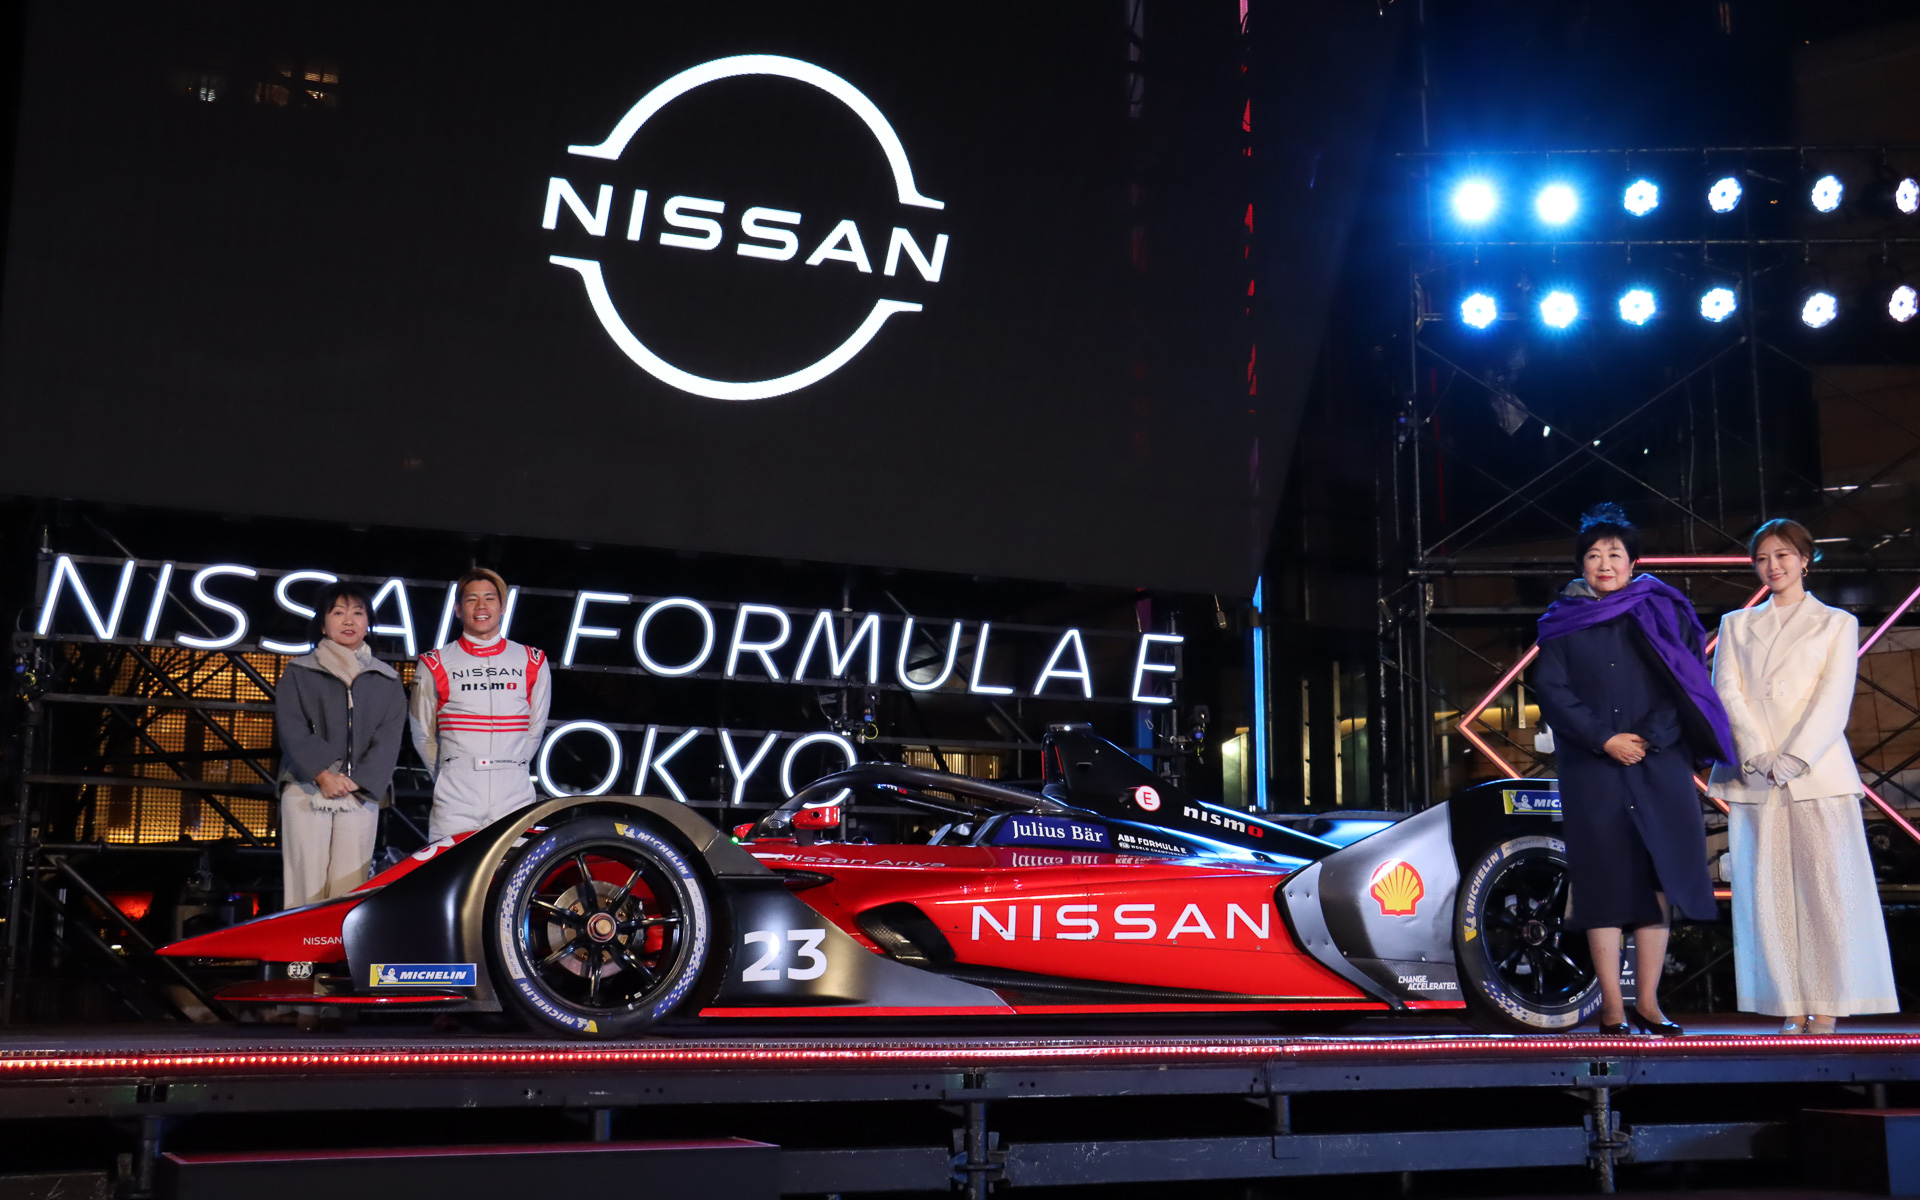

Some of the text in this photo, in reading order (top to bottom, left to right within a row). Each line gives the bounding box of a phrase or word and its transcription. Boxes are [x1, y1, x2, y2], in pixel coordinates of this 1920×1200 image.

[542, 176, 949, 283] NISSAN
[563, 591, 1093, 700] FORMULA
[1131, 633, 1184, 704] E
[452, 667, 523, 680] NISSAN
[461, 682, 517, 692] nismo
[538, 721, 857, 809] OKYO
[1012, 820, 1104, 843] Julius Bär
[1183, 805, 1263, 838] nismo
[637, 831, 690, 875] MICHELIN
[1117, 834, 1136, 844] ABB
[1138, 837, 1180, 852] FORMULA
[1466, 852, 1500, 914] MICHELIN
[970, 902, 1271, 941] NISSAN
[303, 936, 342, 946] NISSAN
[289, 963, 311, 976] FIA
[742, 928, 829, 983] 23
[399, 970, 467, 980] MICHELIN
[1398, 975, 1428, 984] CHANGE.
[1407, 981, 1458, 991] ACCELERATED.
[519, 983, 576, 1026] MICHELIN
